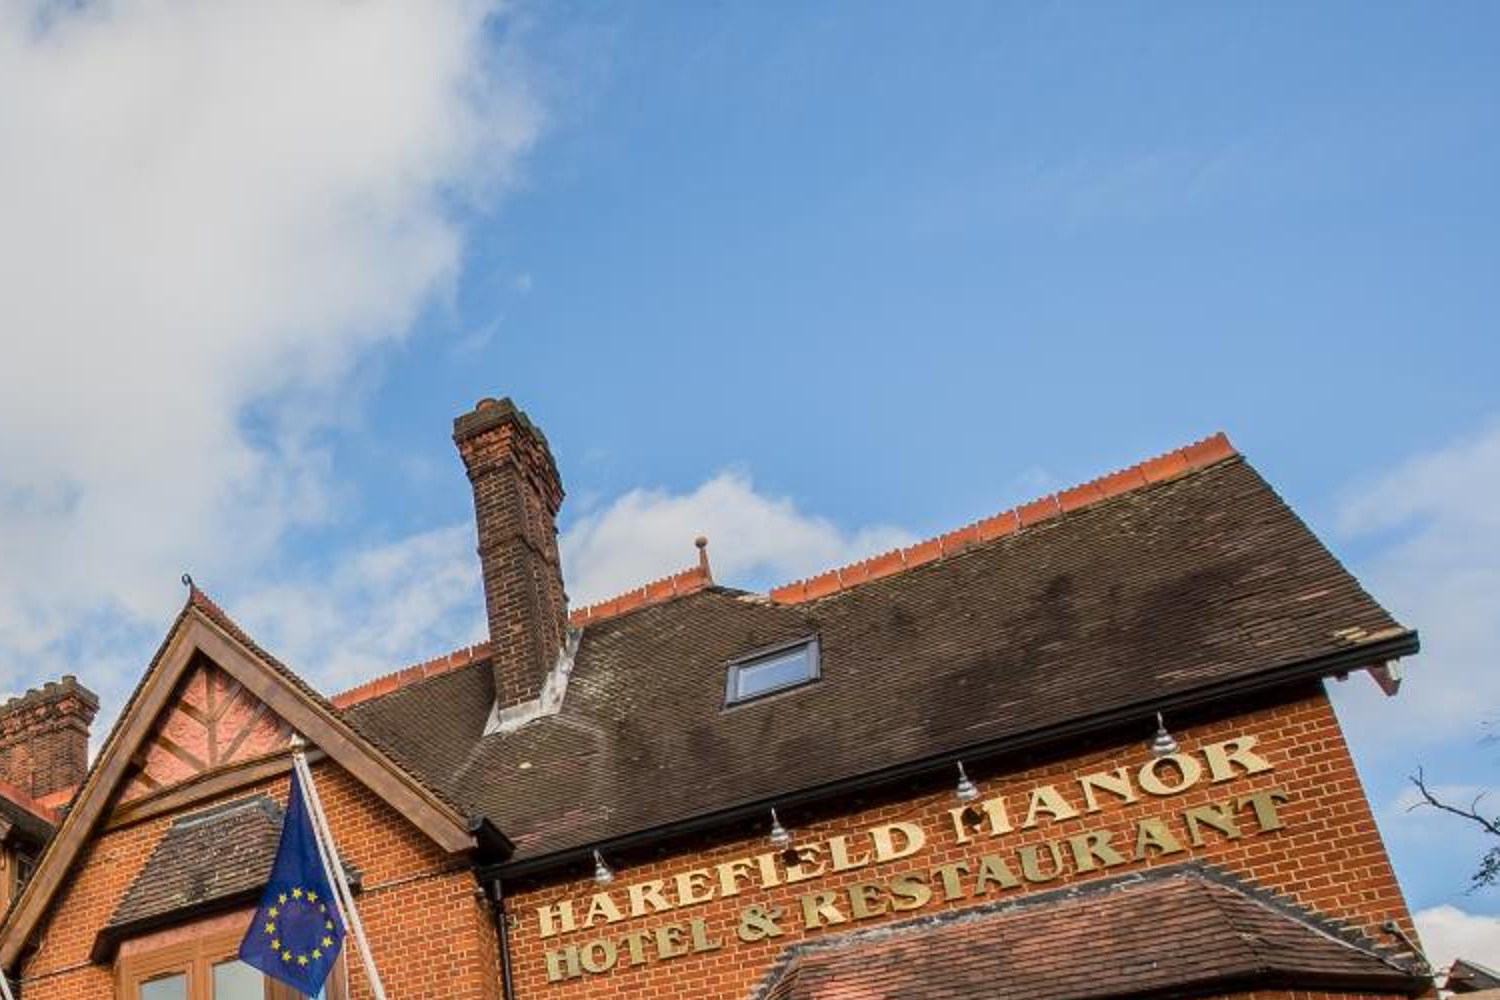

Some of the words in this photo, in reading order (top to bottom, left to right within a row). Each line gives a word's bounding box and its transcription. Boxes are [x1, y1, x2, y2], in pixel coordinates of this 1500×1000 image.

[536, 821, 927, 938] HAREFIELD
[948, 735, 1274, 845] MANOR
[545, 918, 722, 982] HOTEL
[738, 904, 785, 944] &
[802, 788, 1290, 930] RESTAURANT
